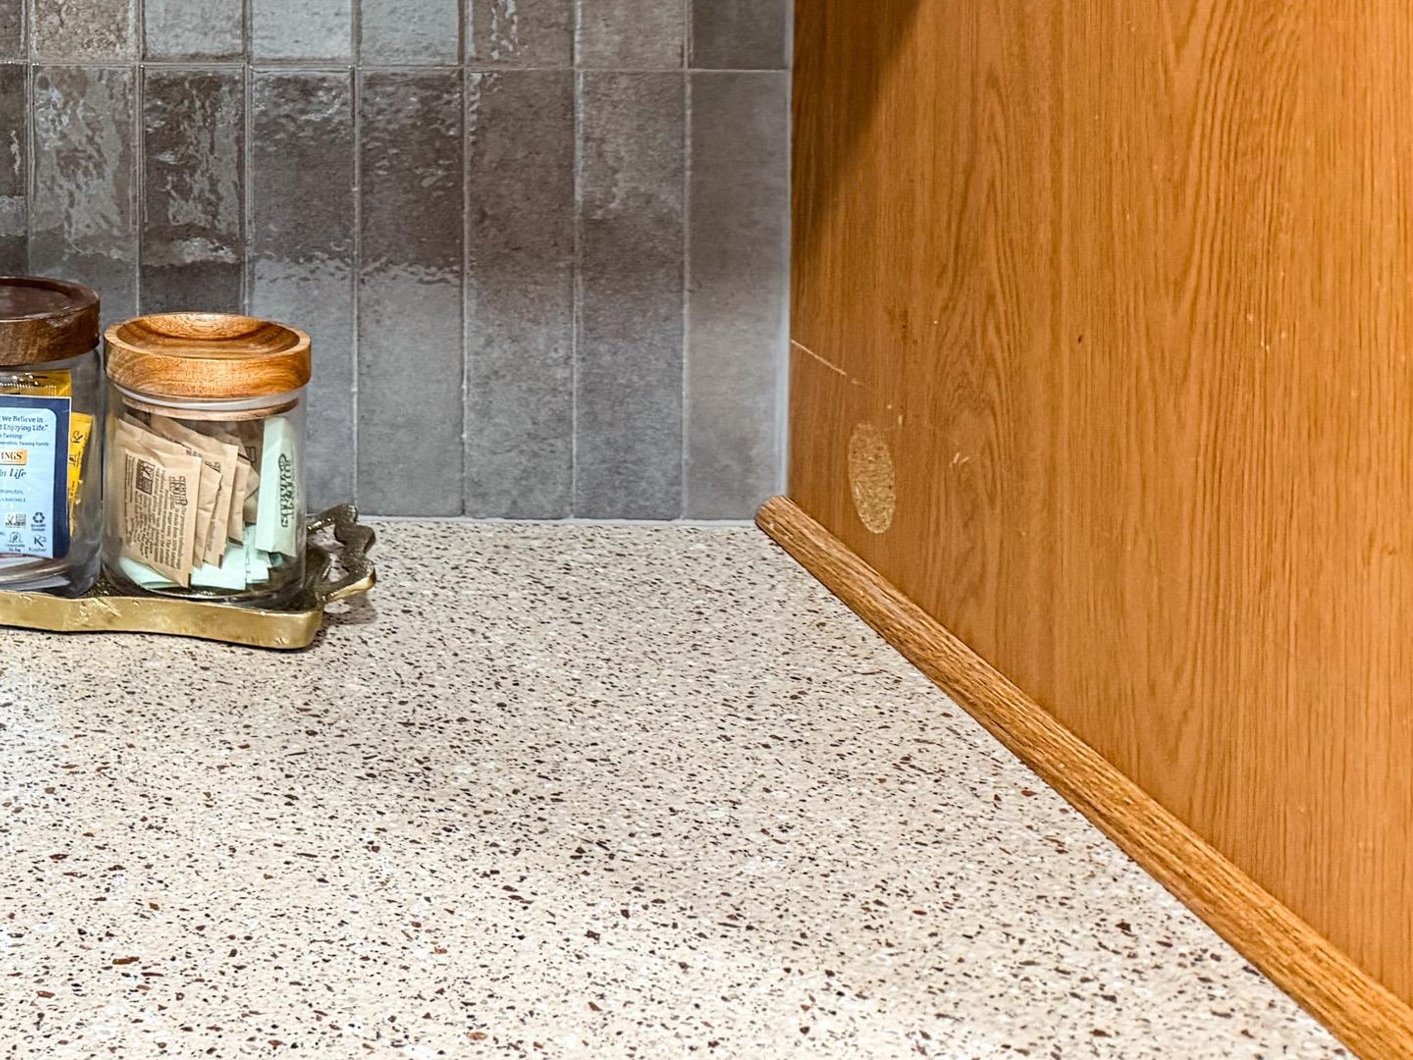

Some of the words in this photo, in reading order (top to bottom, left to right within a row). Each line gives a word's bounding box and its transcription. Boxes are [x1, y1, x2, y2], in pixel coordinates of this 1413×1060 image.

[13, 415, 36, 423] Believe
[3, 424, 32, 433] Enjoying
[9, 468, 27, 479] Life
